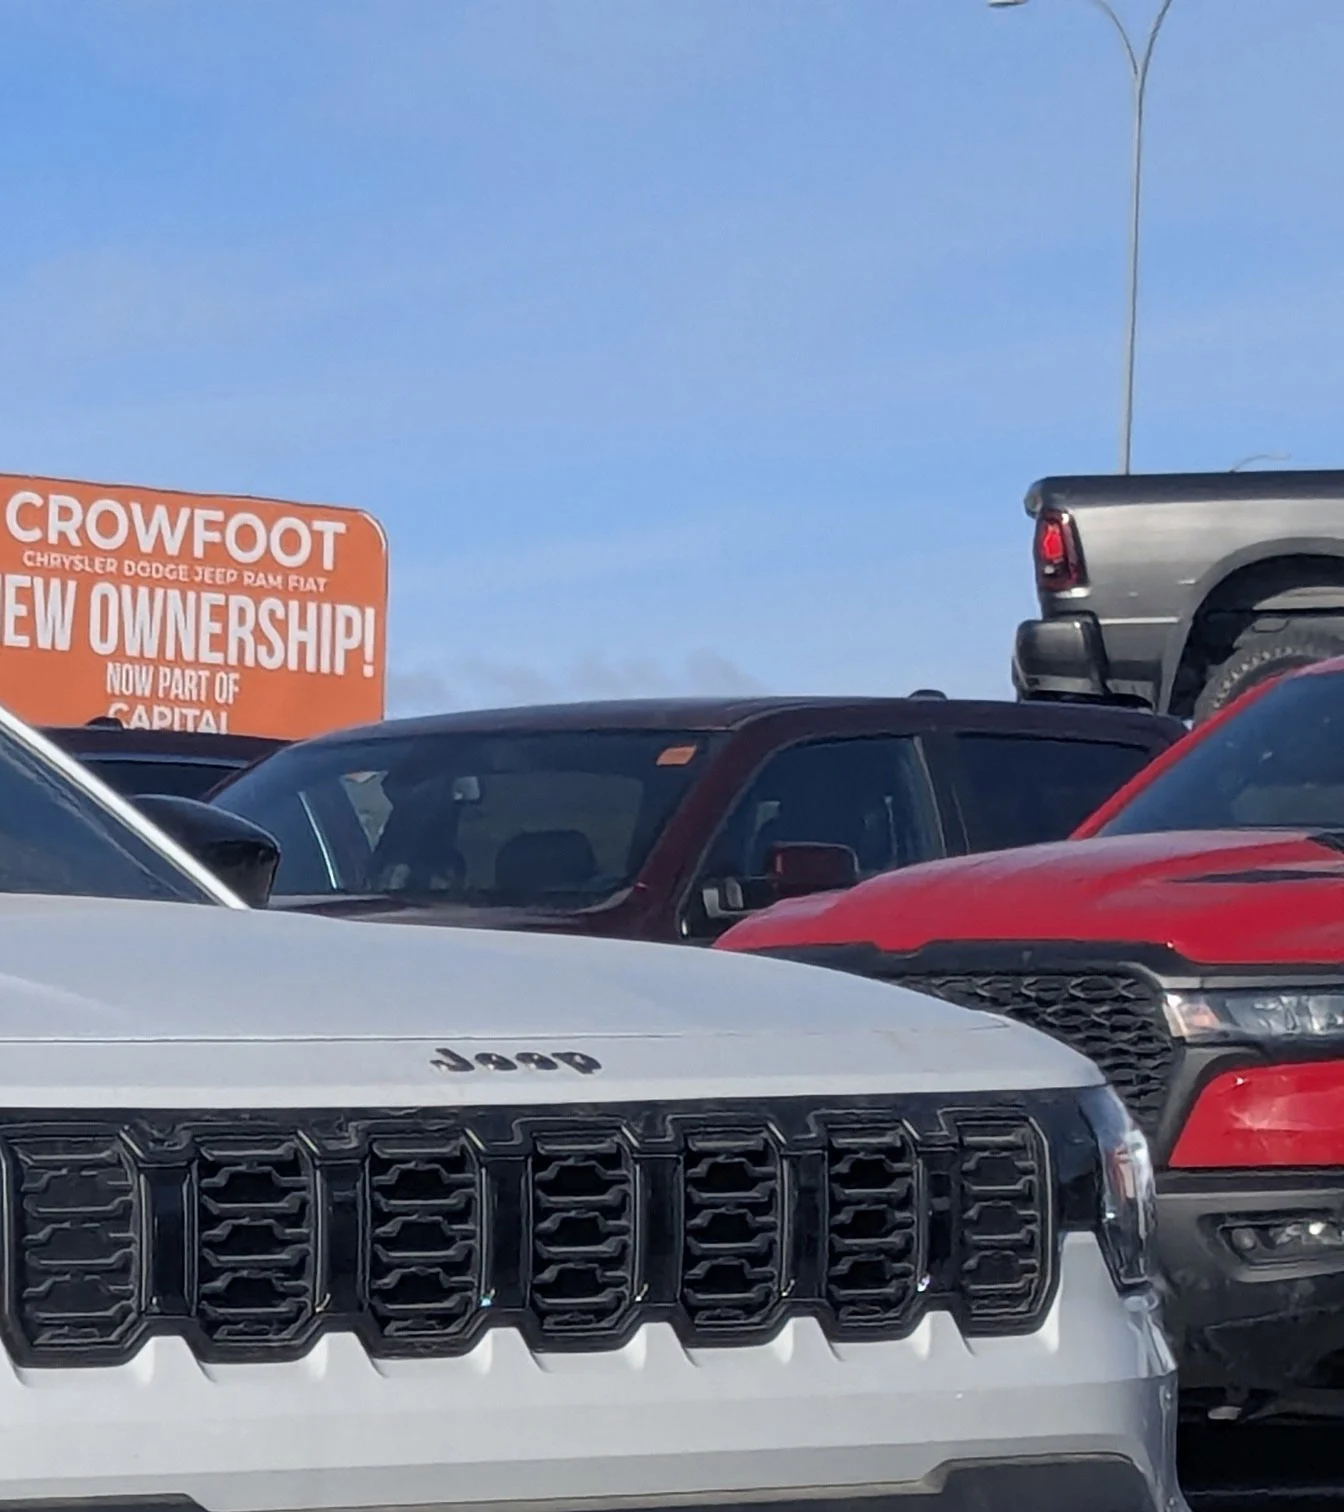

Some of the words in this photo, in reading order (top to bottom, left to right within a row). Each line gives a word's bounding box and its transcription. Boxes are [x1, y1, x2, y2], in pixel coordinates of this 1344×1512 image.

[5, 490, 346, 570] CROWFOOT
[22, 550, 118, 575] CHRYSLER
[123, 560, 189, 582] DODGE
[194, 566, 238, 585] JEEP
[243, 570, 282, 589] RAM
[288, 574, 328, 593] FIAT
[89, 581, 376, 678] OWNERSHIP!
[106, 662, 154, 698] NOW
[158, 665, 211, 702] PART
[214, 671, 240, 705] OF
[429, 1047, 603, 1076] Jeep
